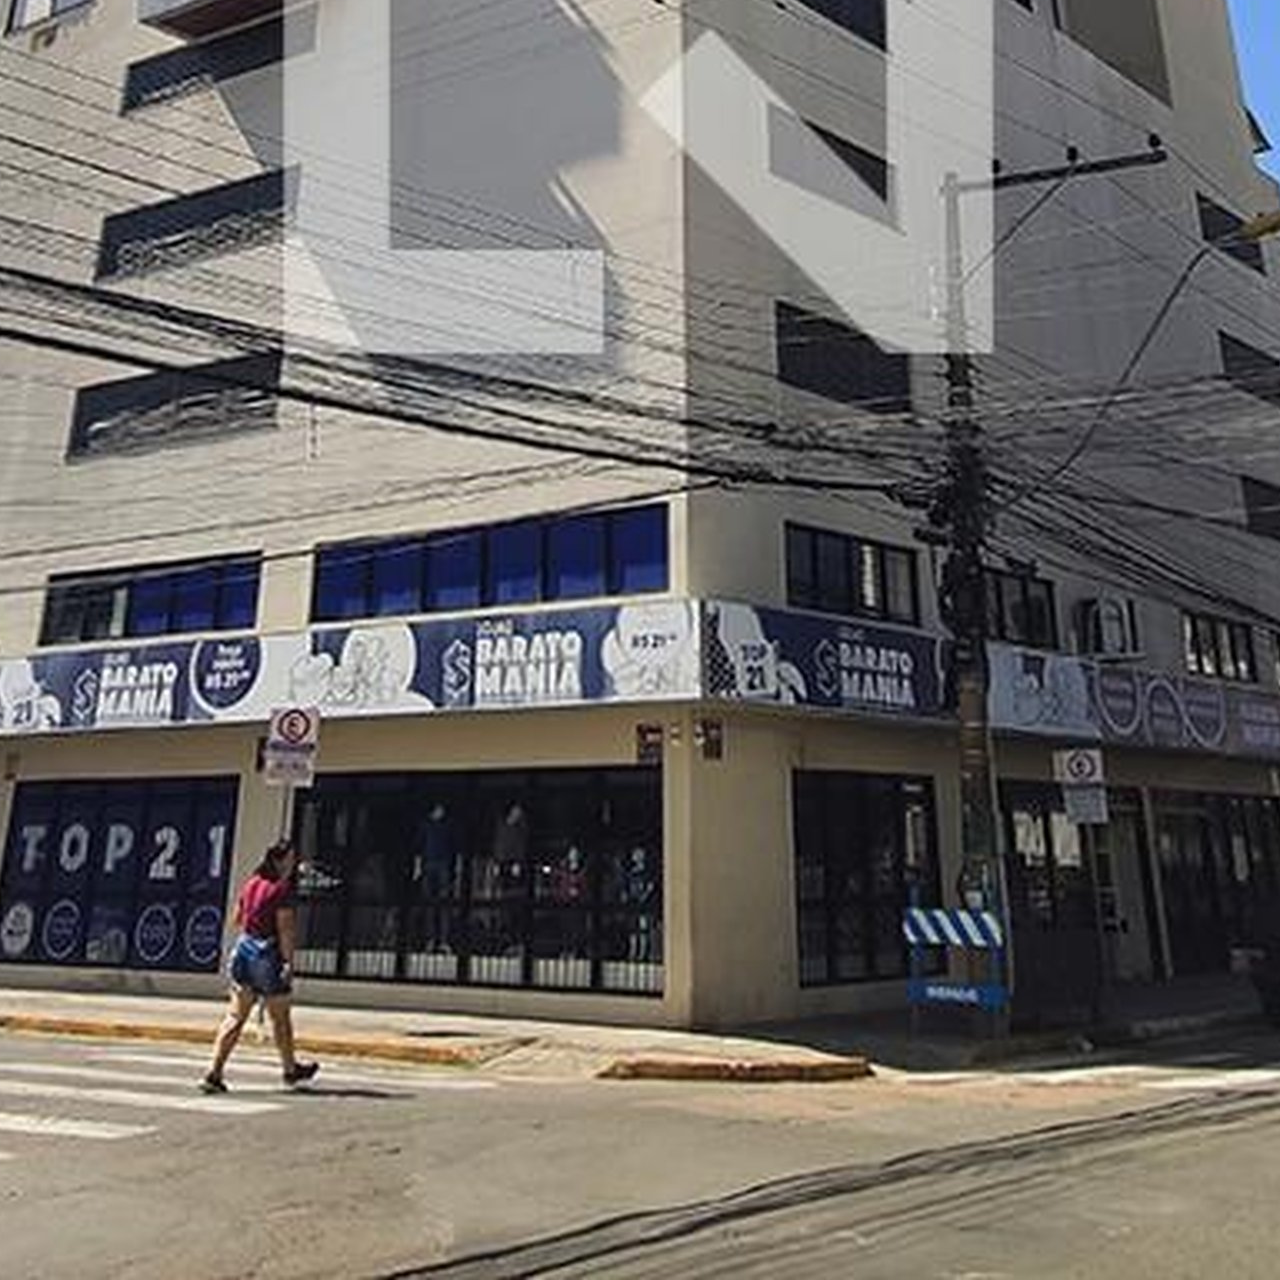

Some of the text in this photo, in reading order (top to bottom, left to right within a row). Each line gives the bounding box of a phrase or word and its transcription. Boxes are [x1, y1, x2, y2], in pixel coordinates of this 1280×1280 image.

[477, 631, 582, 662] BARATO
[838, 641, 914, 674] BARATO
[100, 663, 178, 689] BARATO
[475, 661, 581, 697] MANIA
[839, 671, 916, 708] MANIA
[96, 688, 173, 718] MANIA
